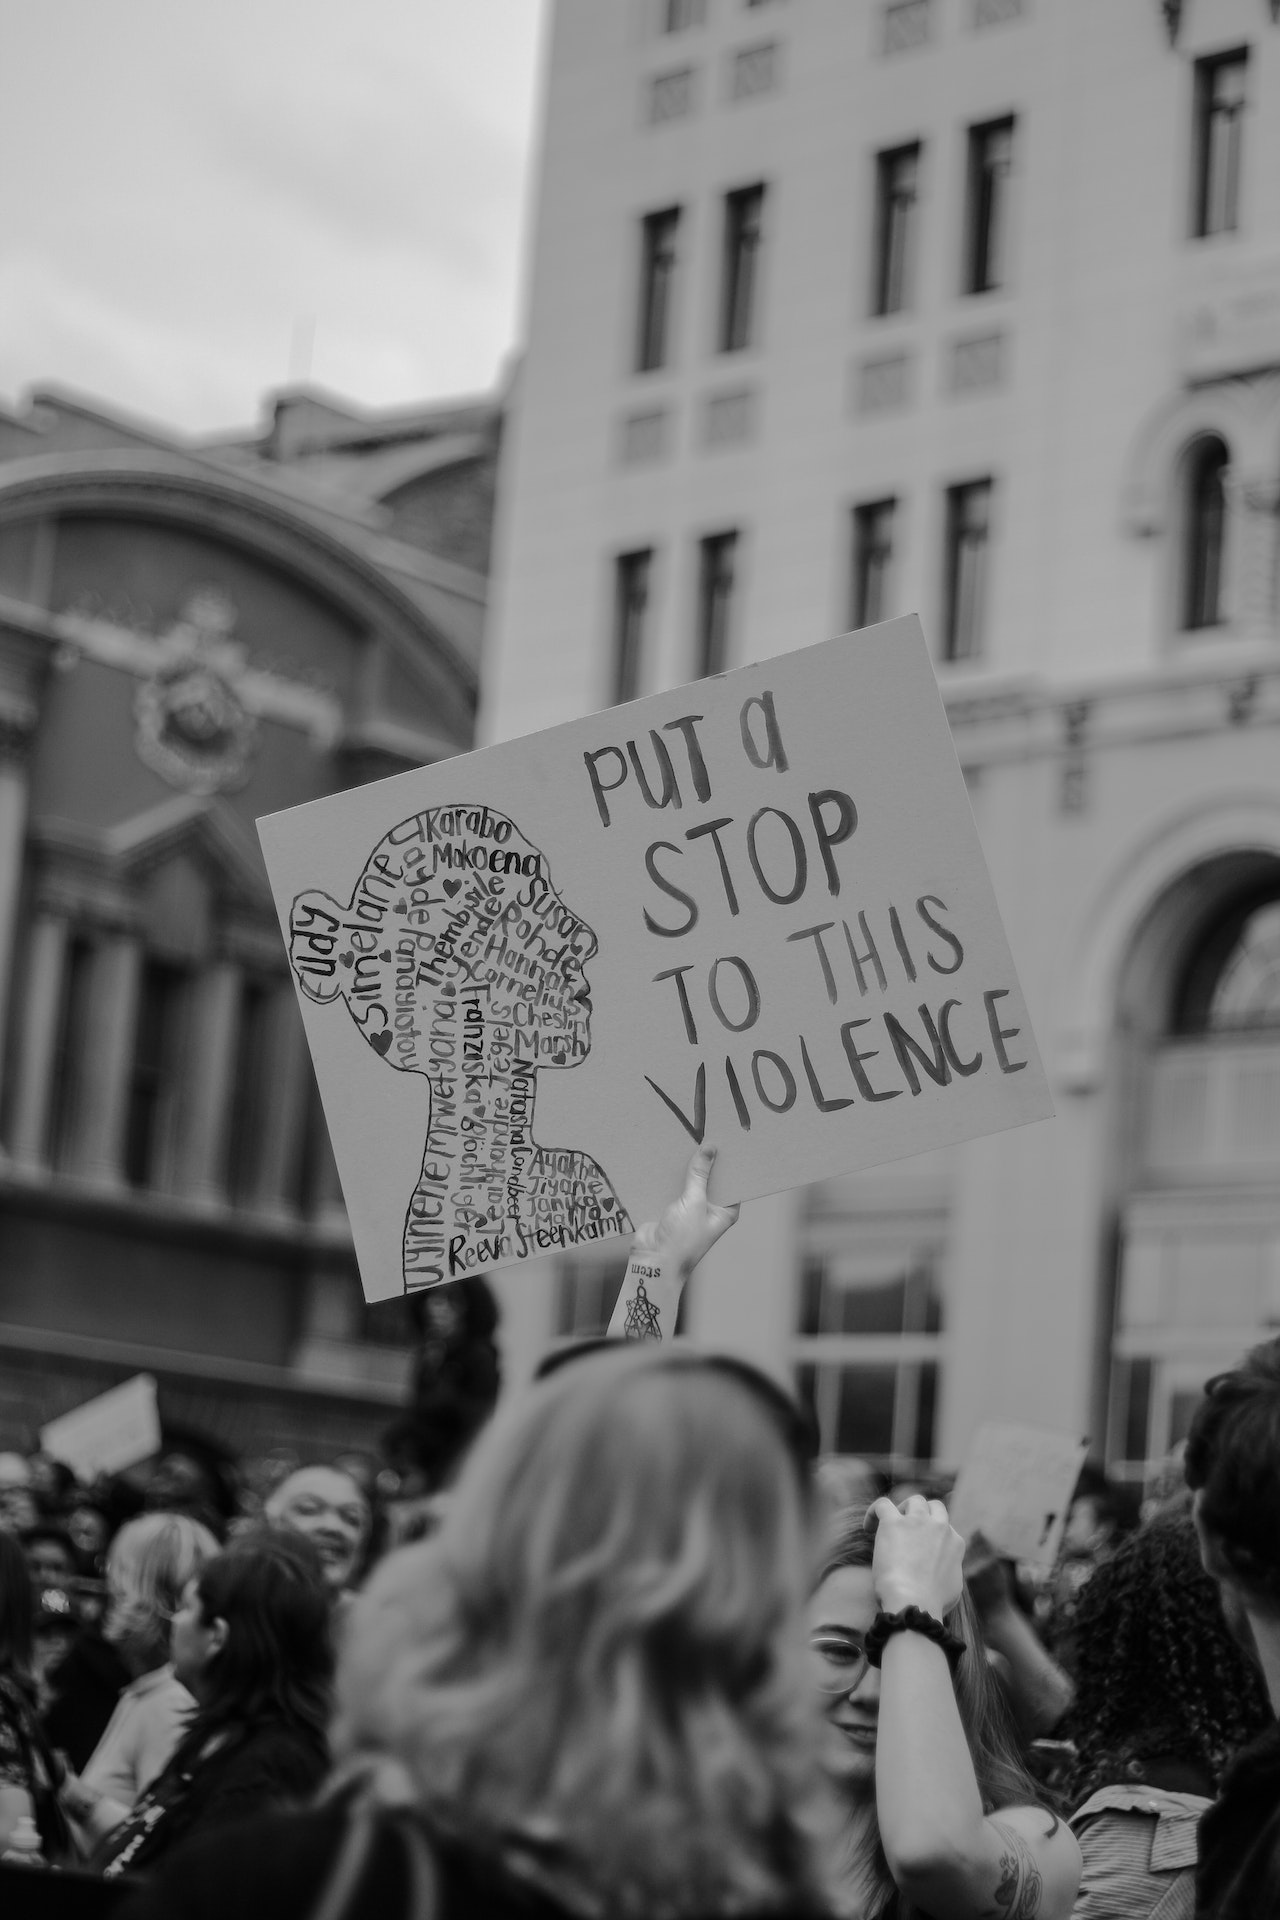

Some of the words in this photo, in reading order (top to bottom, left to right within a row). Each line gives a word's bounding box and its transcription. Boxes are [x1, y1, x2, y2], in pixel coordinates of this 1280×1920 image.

[583, 714, 712, 828] PUT
[427, 806, 512, 844] Karabo
[432, 839, 541, 878] Makoena
[643, 789, 858, 939] STOP
[342, 854, 404, 1028] Simelane
[492, 899, 582, 976] Rohde
[516, 876, 598, 957] Susan
[484, 934, 577, 998] Hannah
[652, 955, 762, 1045] TO
[784, 895, 964, 1006] THIS
[514, 1028, 588, 1059] Marsh
[644, 988, 1028, 1146] VIOLENCE
[509, 1057, 535, 1145] Natasha
[405, 1161, 451, 1289] Uyinene
[525, 1176, 604, 1197] Jiyane
[449, 1234, 513, 1277] Reeva
[516, 1208, 627, 1259] Steenkamp
